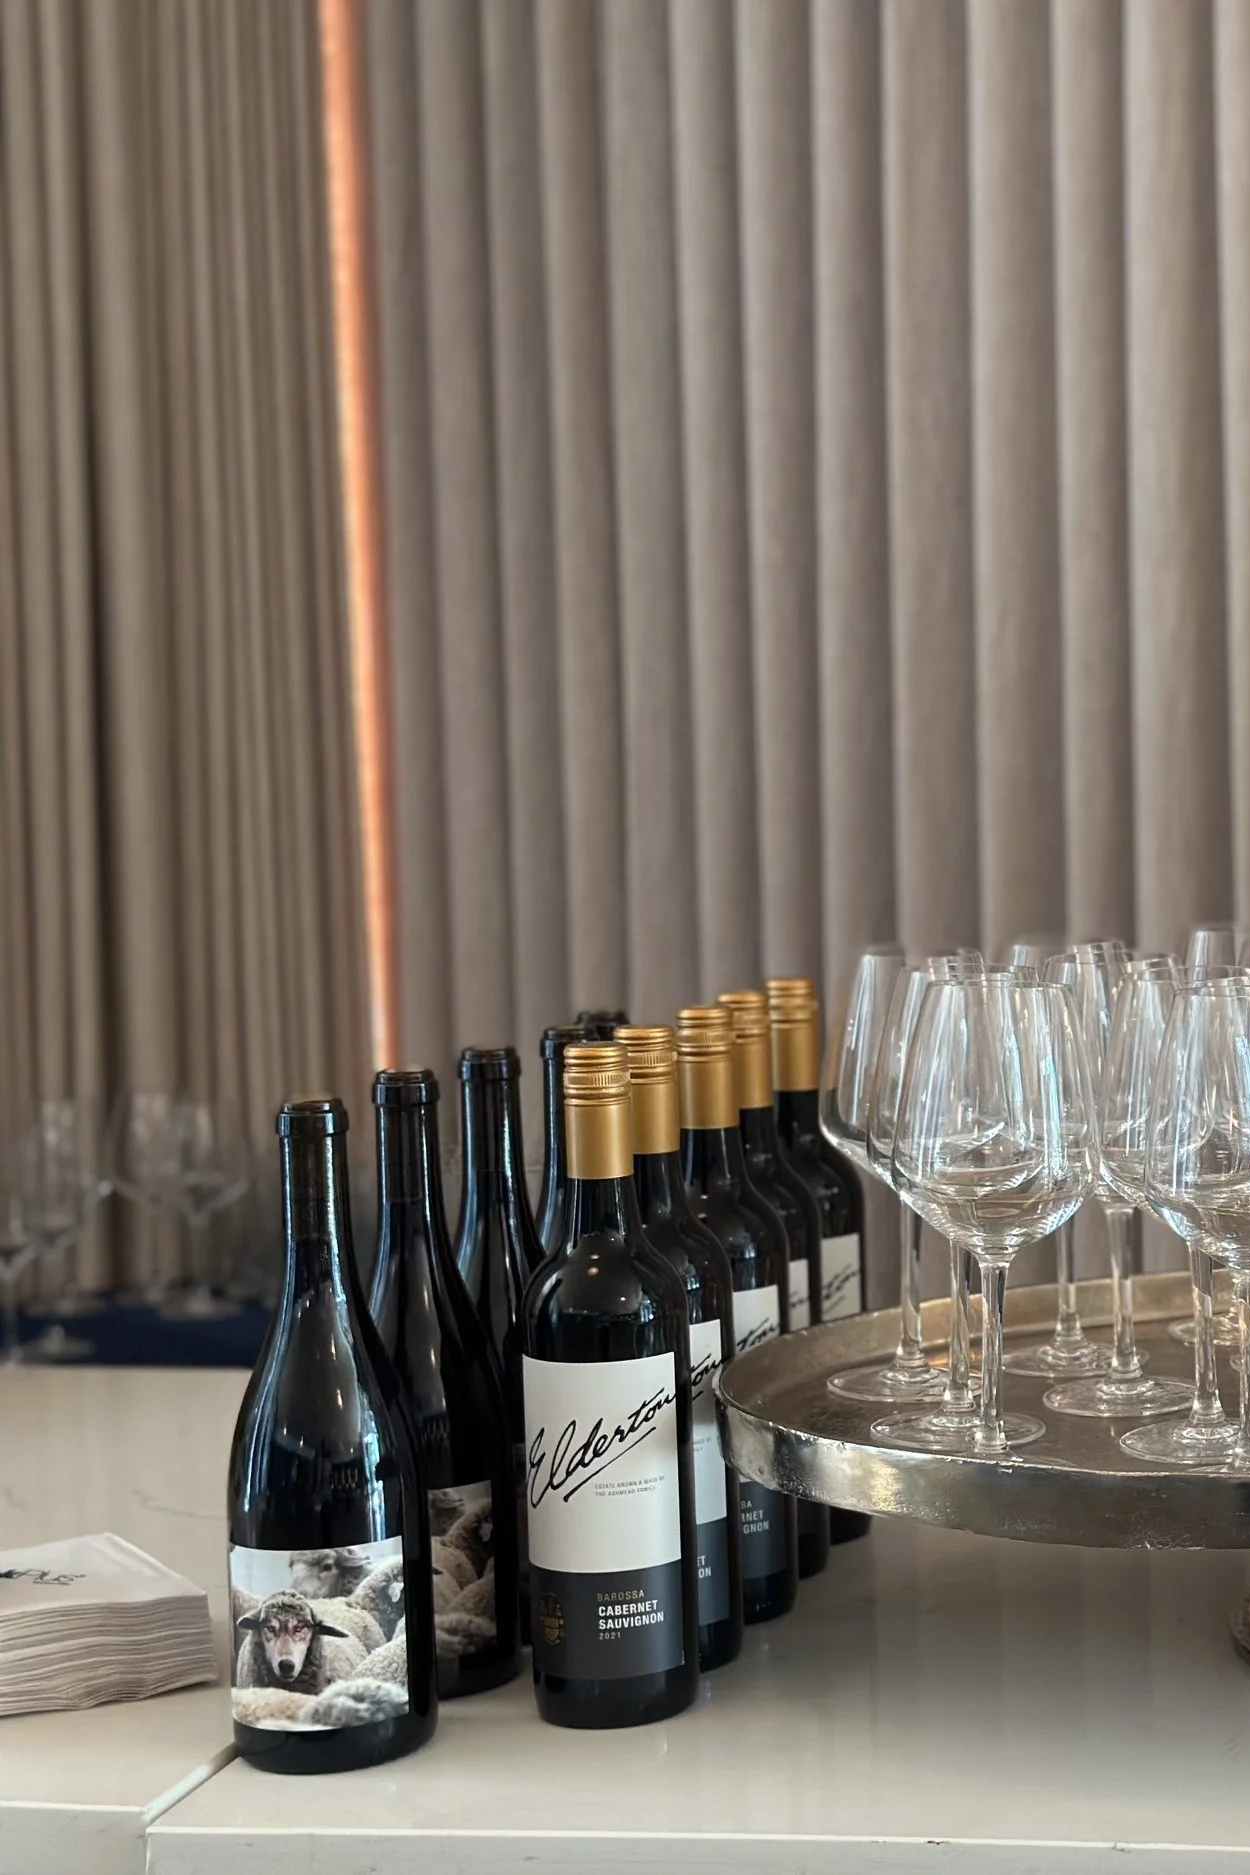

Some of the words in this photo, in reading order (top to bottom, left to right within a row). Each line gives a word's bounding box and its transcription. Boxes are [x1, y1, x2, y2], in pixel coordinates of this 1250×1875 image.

[526, 1387, 677, 1509] Elderton
[597, 1589, 645, 1602] BAROSSA
[598, 1599, 658, 1617] CABERNET
[598, 1611, 665, 1630] SAUVIGNON
[599, 1632, 621, 1640] 2021
